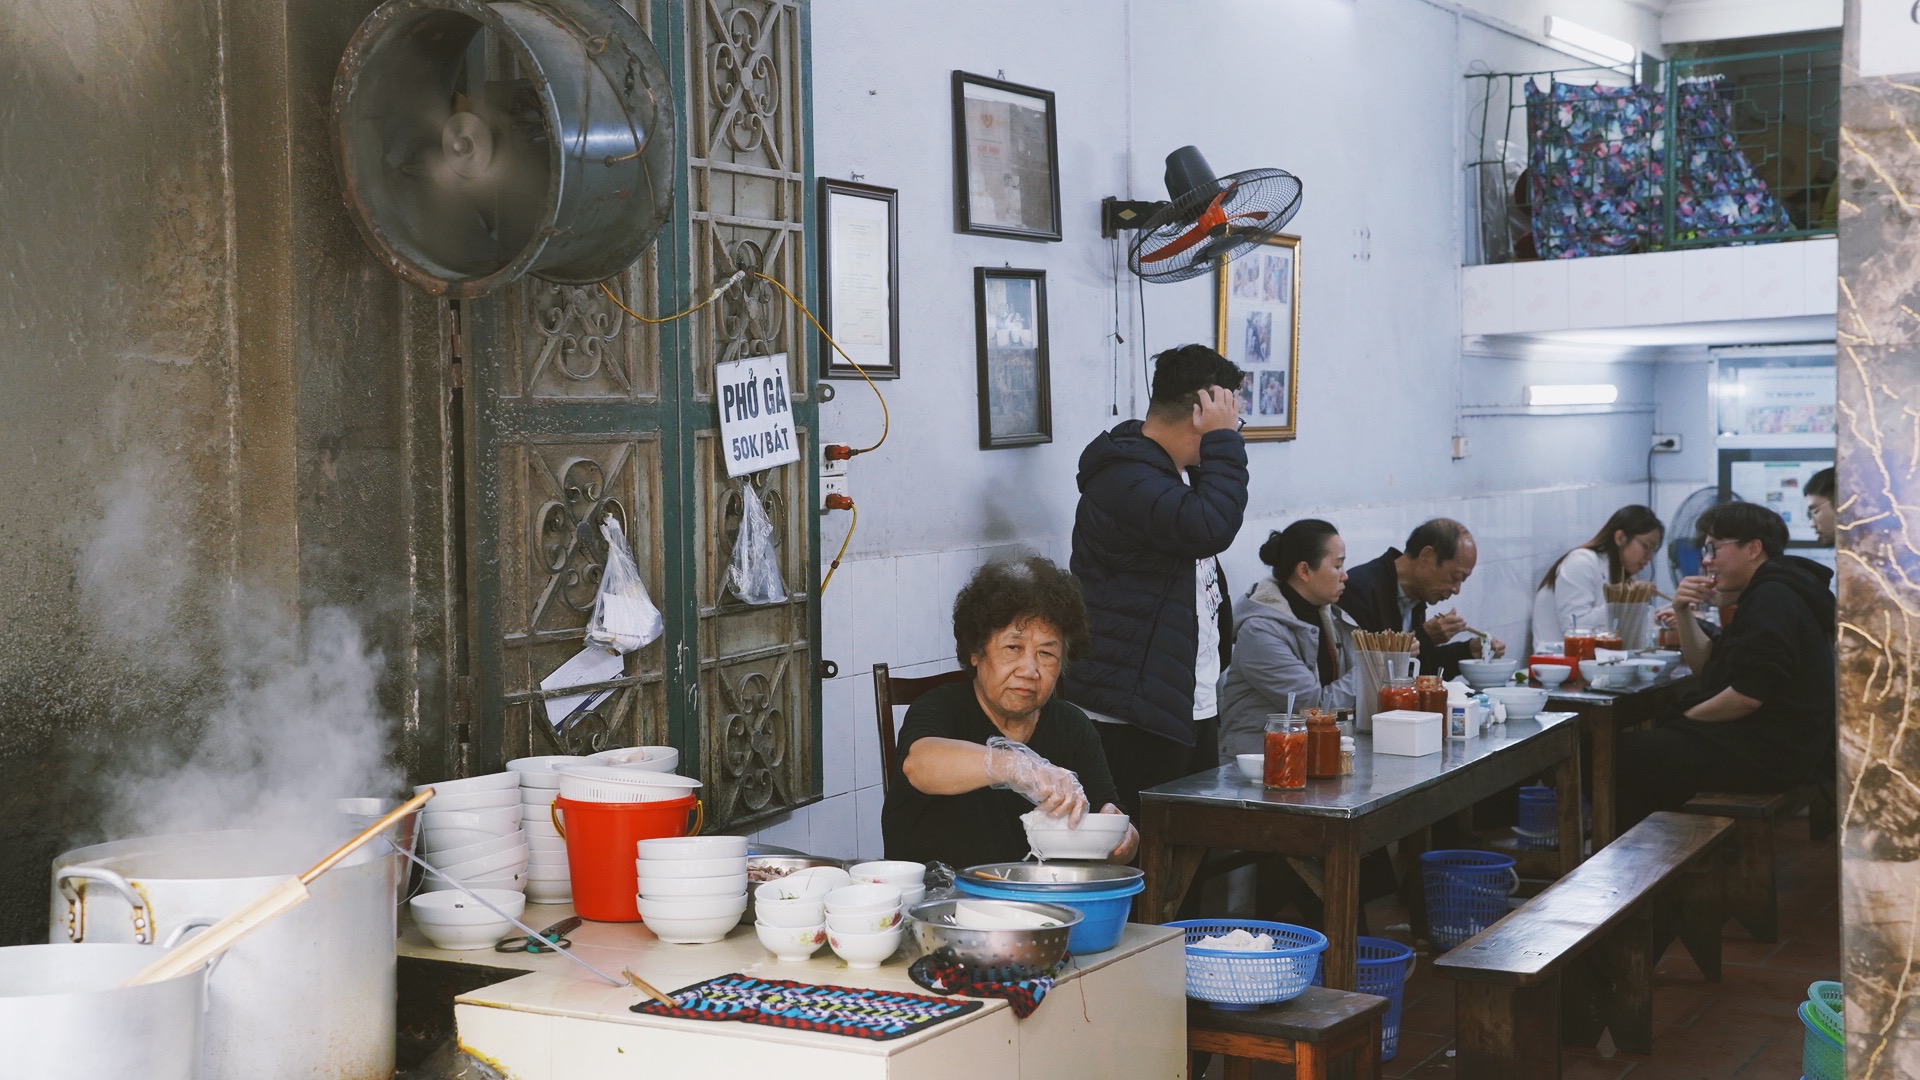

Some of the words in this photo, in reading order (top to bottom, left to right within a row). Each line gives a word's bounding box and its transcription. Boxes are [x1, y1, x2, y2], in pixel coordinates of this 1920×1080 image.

[723, 368, 759, 423] PHỞ
[763, 368, 788, 415] GÀ
[732, 423, 789, 461] 50K/BÁT
